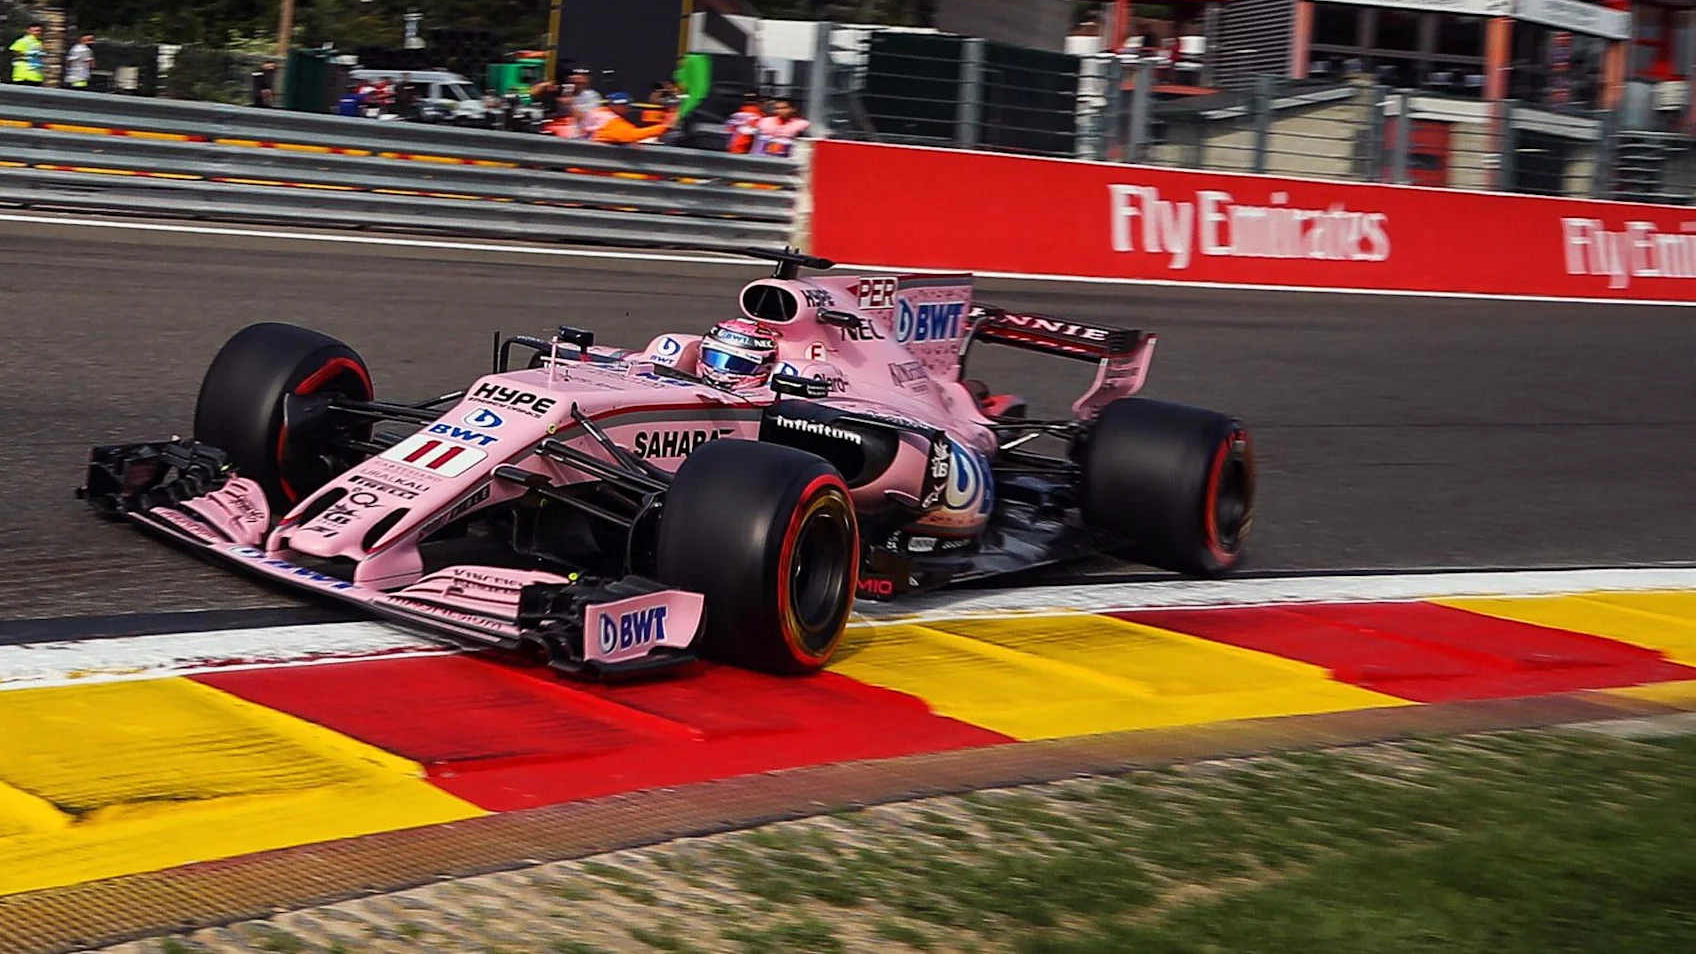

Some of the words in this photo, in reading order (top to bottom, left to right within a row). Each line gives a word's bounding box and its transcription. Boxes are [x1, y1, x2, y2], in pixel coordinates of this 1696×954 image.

[1109, 184, 1192, 269] Fly
[1197, 191, 1391, 262] Emirates
[1561, 217, 1629, 288] Fly
[859, 279, 894, 307] PER
[915, 302, 964, 343] BWT
[754, 338, 774, 349] NEC
[472, 382, 557, 415] HYPE
[428, 423, 499, 447] BWT
[776, 415, 862, 446] infinitum
[402, 439, 466, 471] 11
[360, 467, 431, 493] URALKALI
[619, 606, 667, 648] BWT
